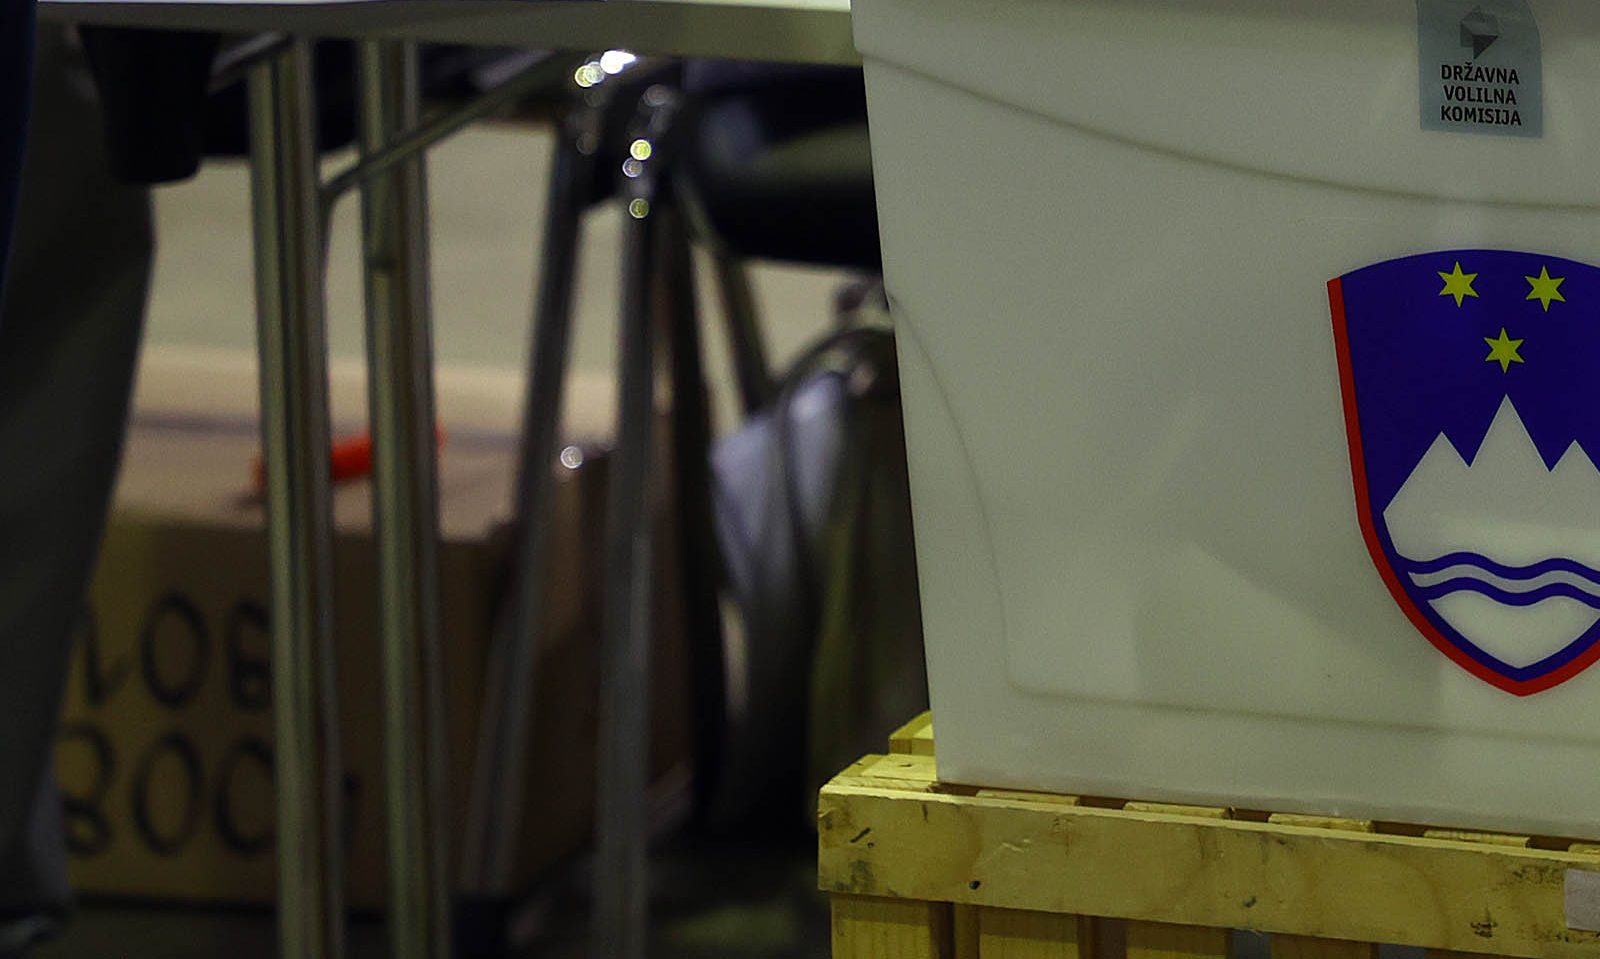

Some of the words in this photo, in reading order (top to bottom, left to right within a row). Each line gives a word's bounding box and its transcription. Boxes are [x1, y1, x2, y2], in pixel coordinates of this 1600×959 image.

[1441, 61, 1520, 85] DRŽAVNA
[1443, 84, 1517, 106] VOLILNA
[1440, 104, 1522, 126] KOMISIJA
